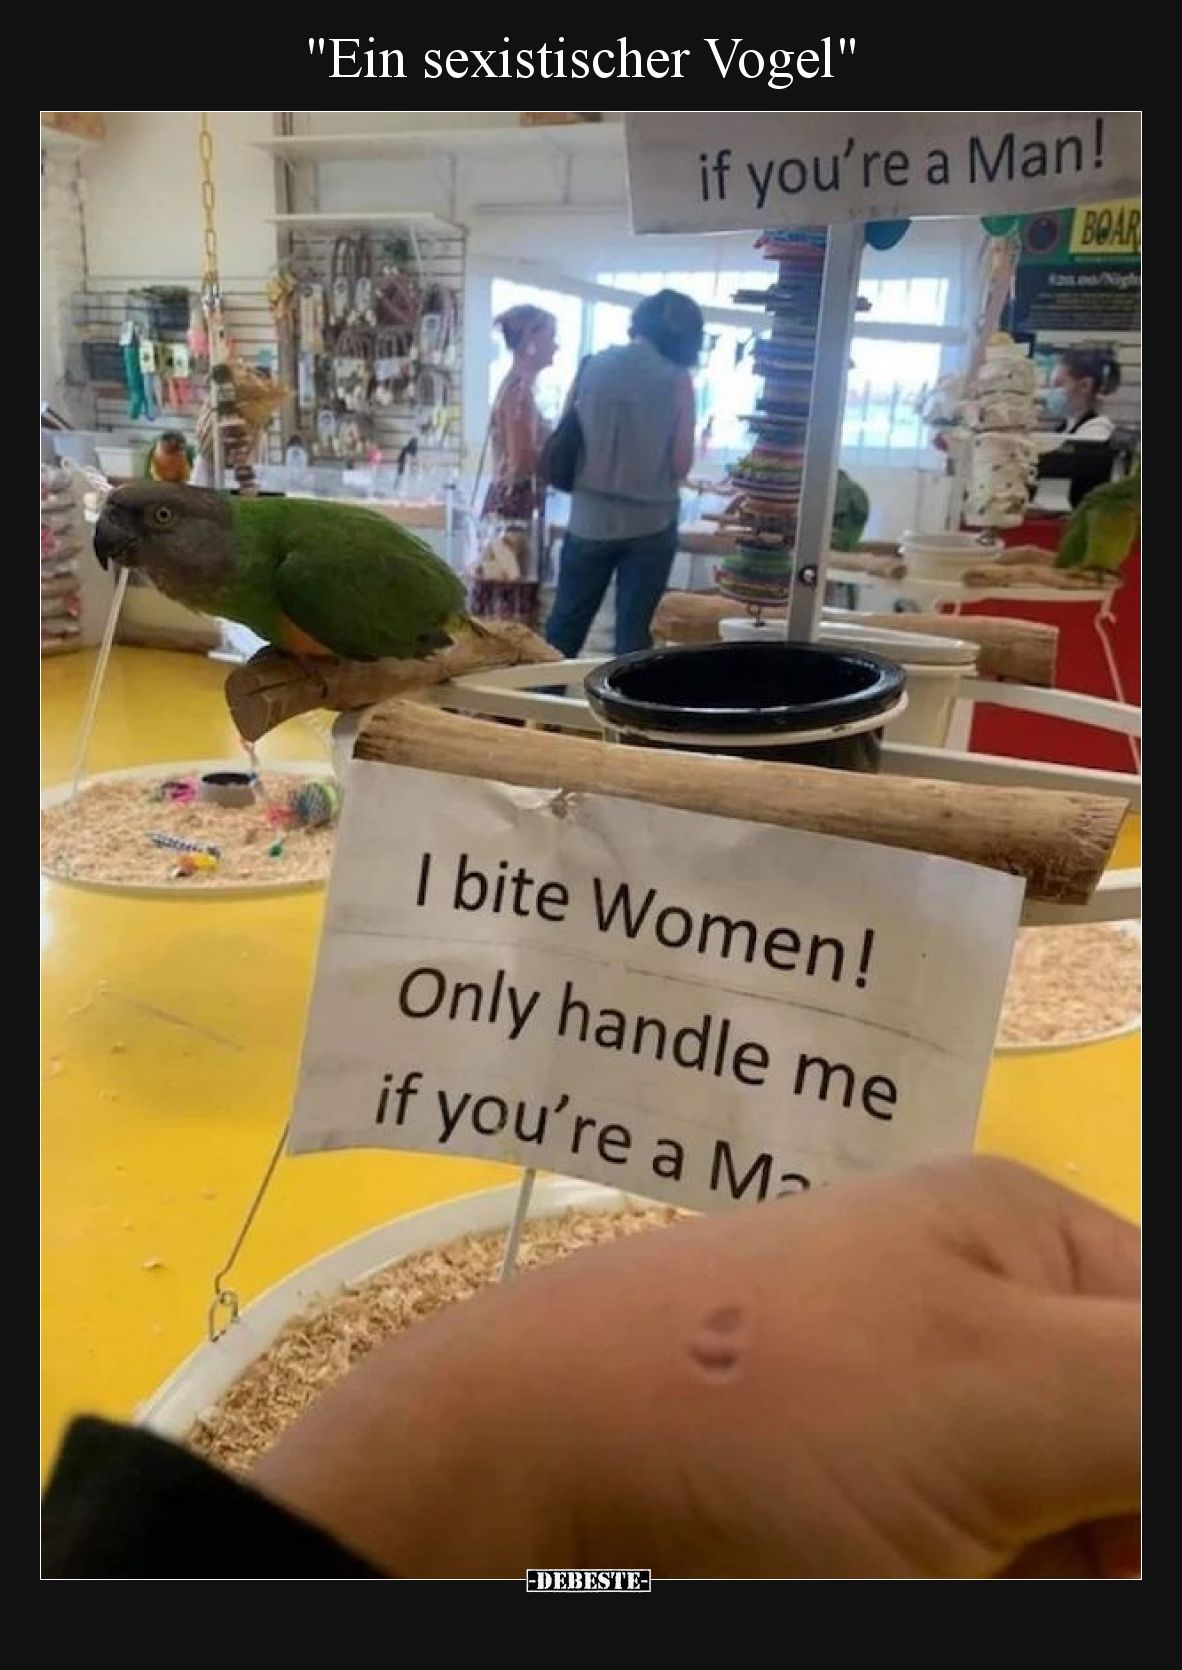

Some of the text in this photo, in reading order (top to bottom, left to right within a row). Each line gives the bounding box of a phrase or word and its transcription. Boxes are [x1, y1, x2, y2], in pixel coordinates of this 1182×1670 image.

[699, 149, 732, 202] if
[927, 149, 950, 186] a
[969, 118, 1103, 184] Man!
[416, 851, 876, 989] I bite Women!
[398, 966, 898, 1122] Only handle me
[374, 1071, 424, 1126] if
[652, 1138, 685, 1182] a
[709, 1140, 814, 1203] Ma
